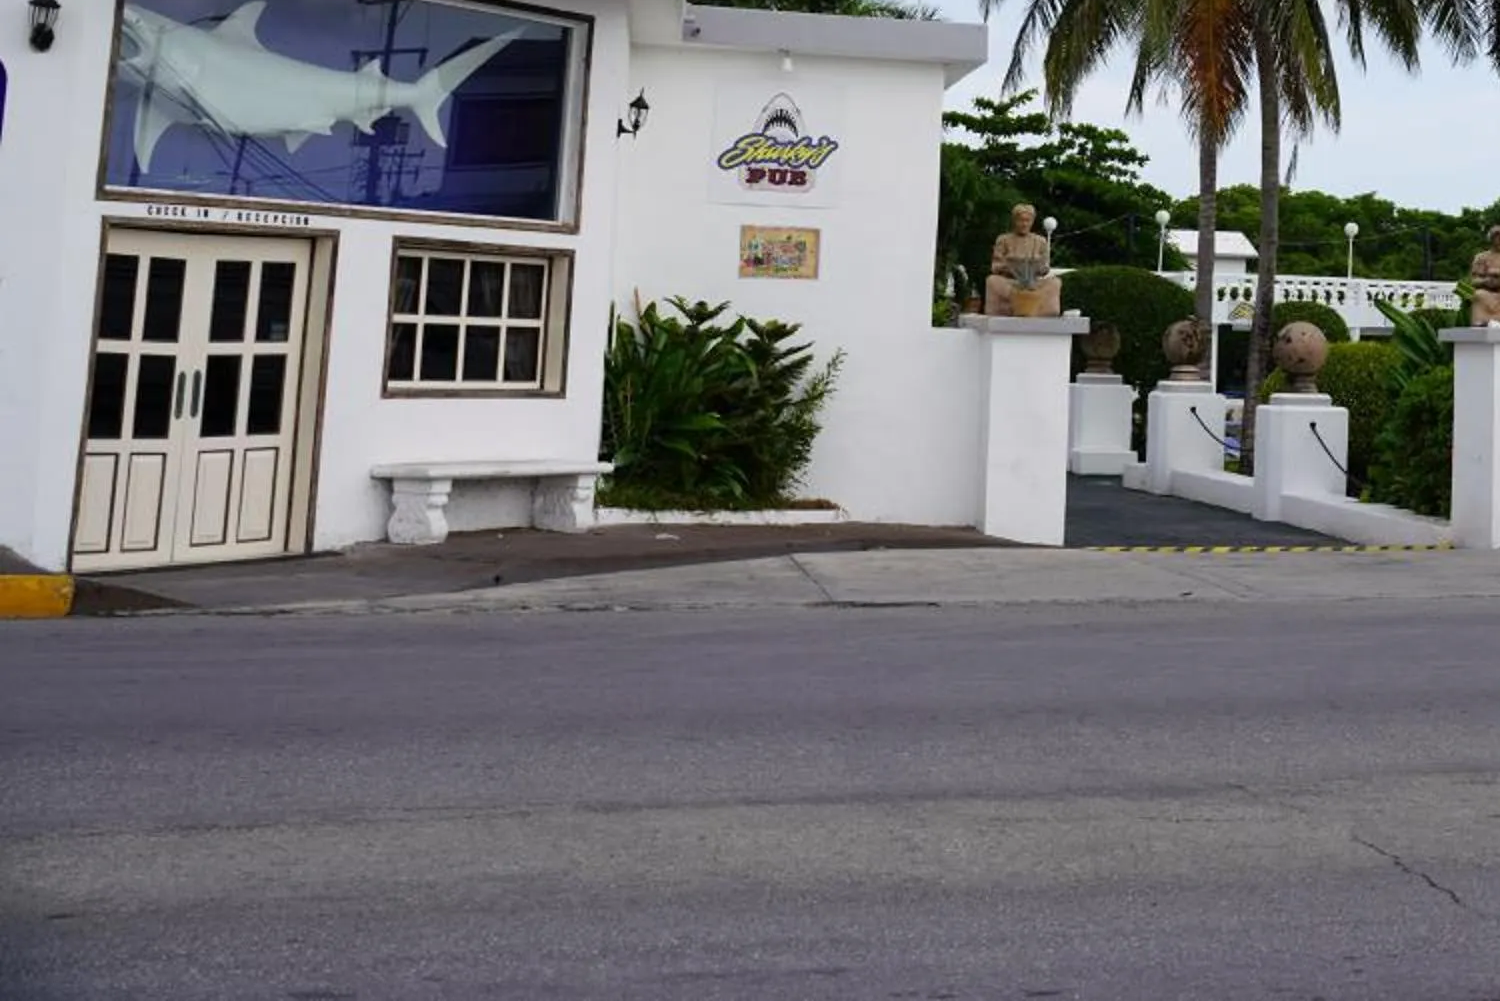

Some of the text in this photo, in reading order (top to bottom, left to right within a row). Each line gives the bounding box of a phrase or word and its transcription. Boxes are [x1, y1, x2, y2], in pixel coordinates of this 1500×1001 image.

[745, 166, 807, 185] PUB
[147, 205, 186, 216] CHECK
[197, 208, 209, 218] IN
